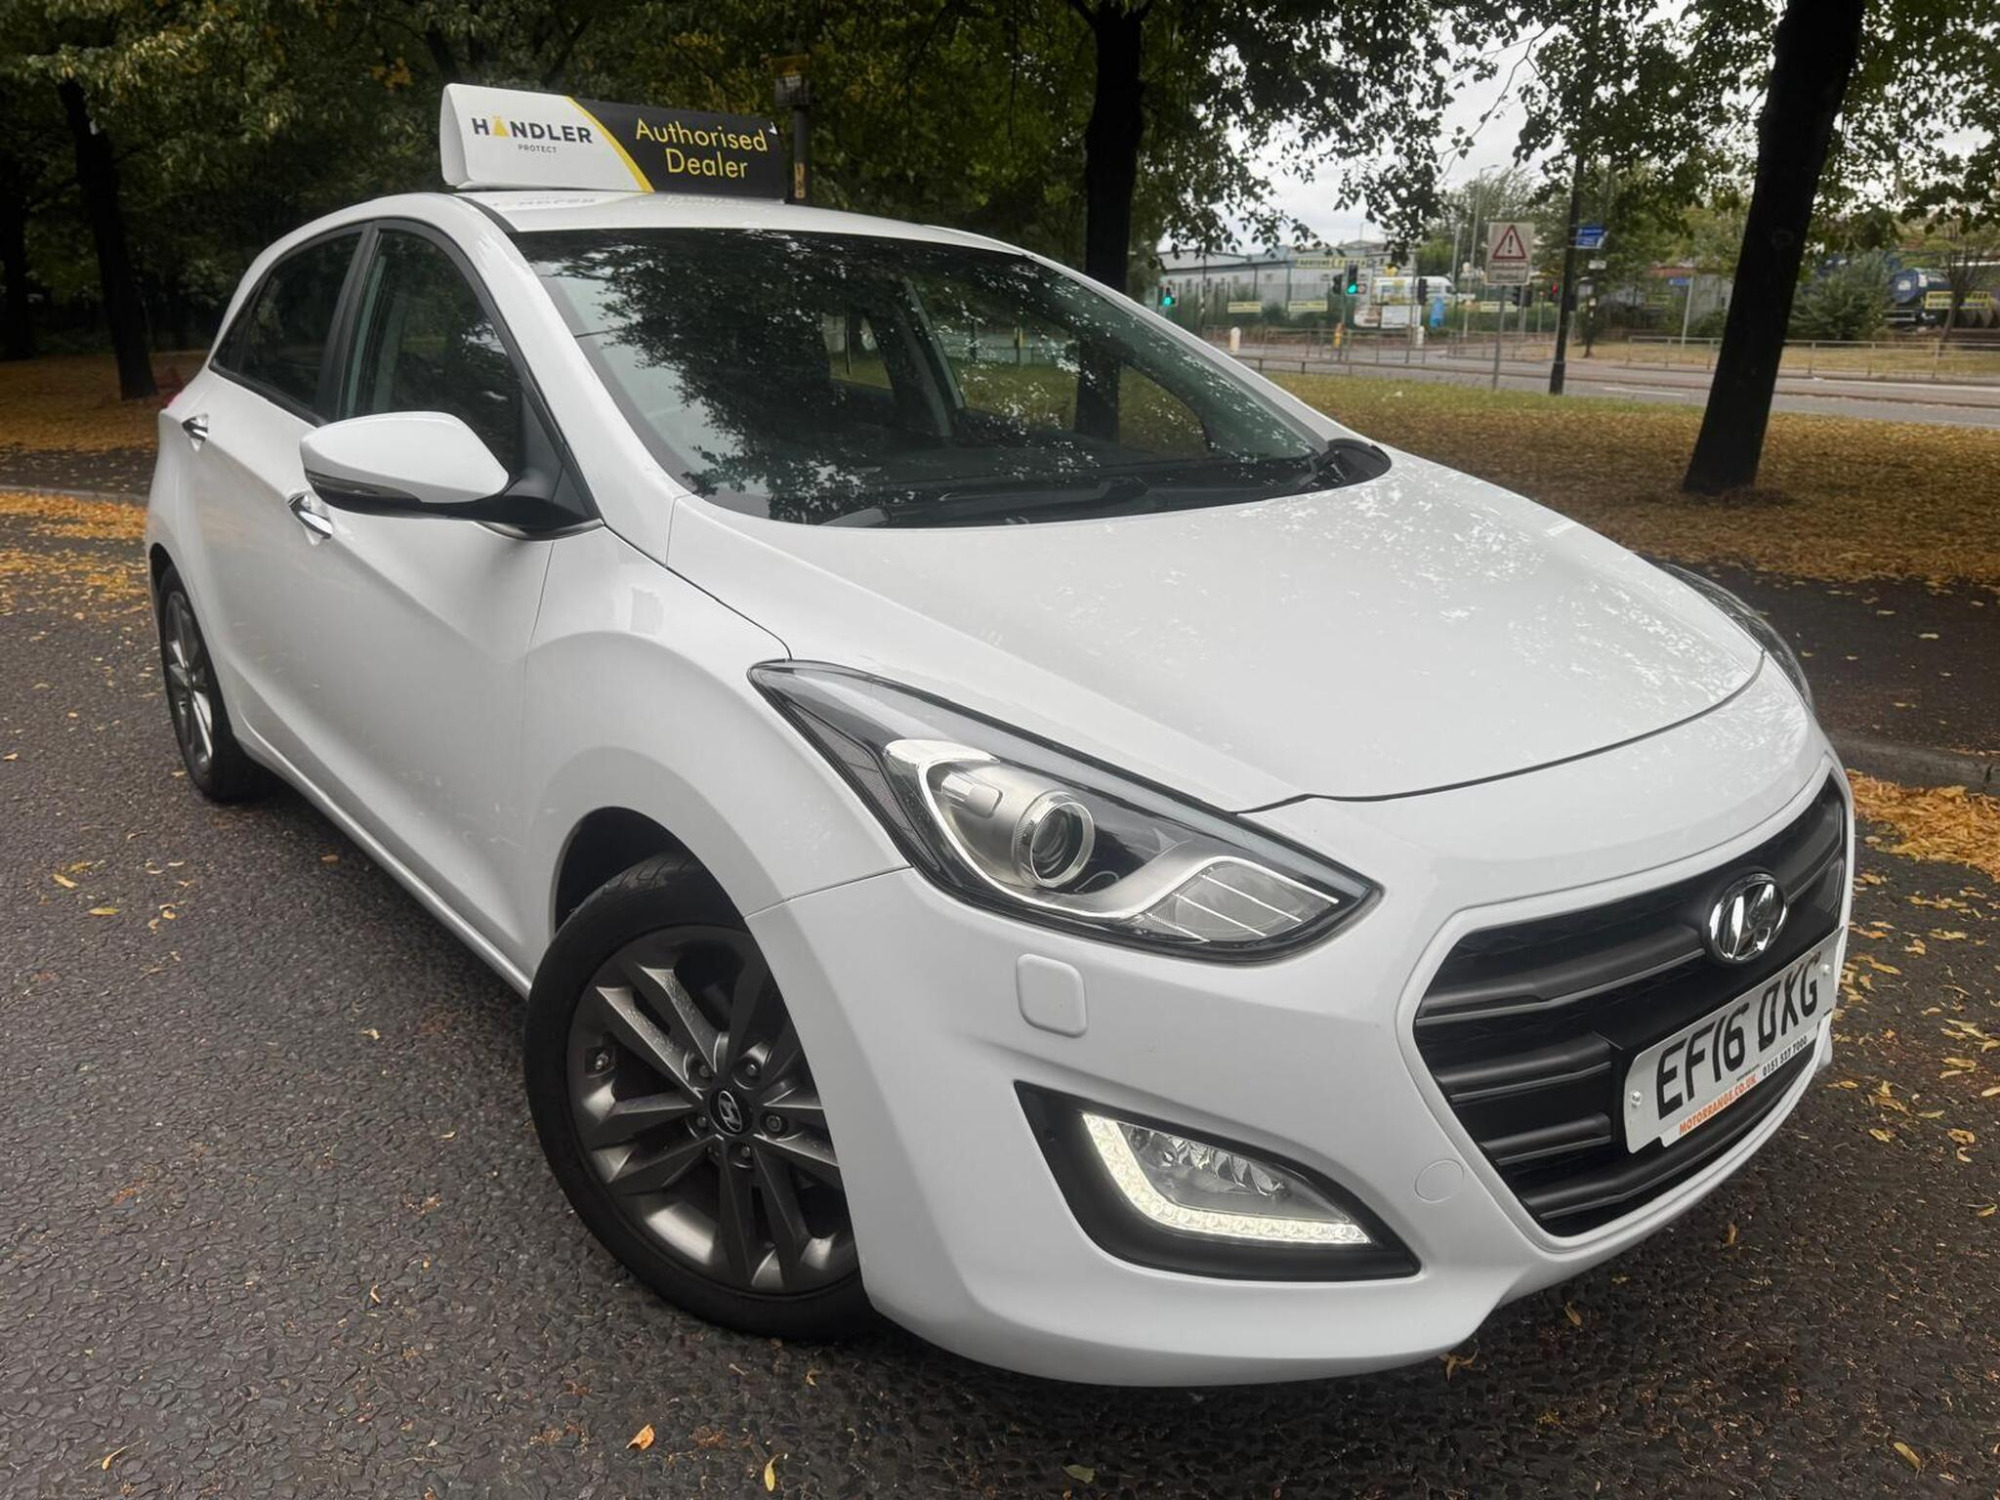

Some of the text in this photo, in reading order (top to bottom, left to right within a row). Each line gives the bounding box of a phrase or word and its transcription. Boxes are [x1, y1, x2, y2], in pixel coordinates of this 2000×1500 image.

[518, 144, 557, 153] PROTECT
[636, 118, 767, 151] Authorised
[665, 147, 748, 178] Dealer
[1656, 1002, 1750, 1121] EF16
